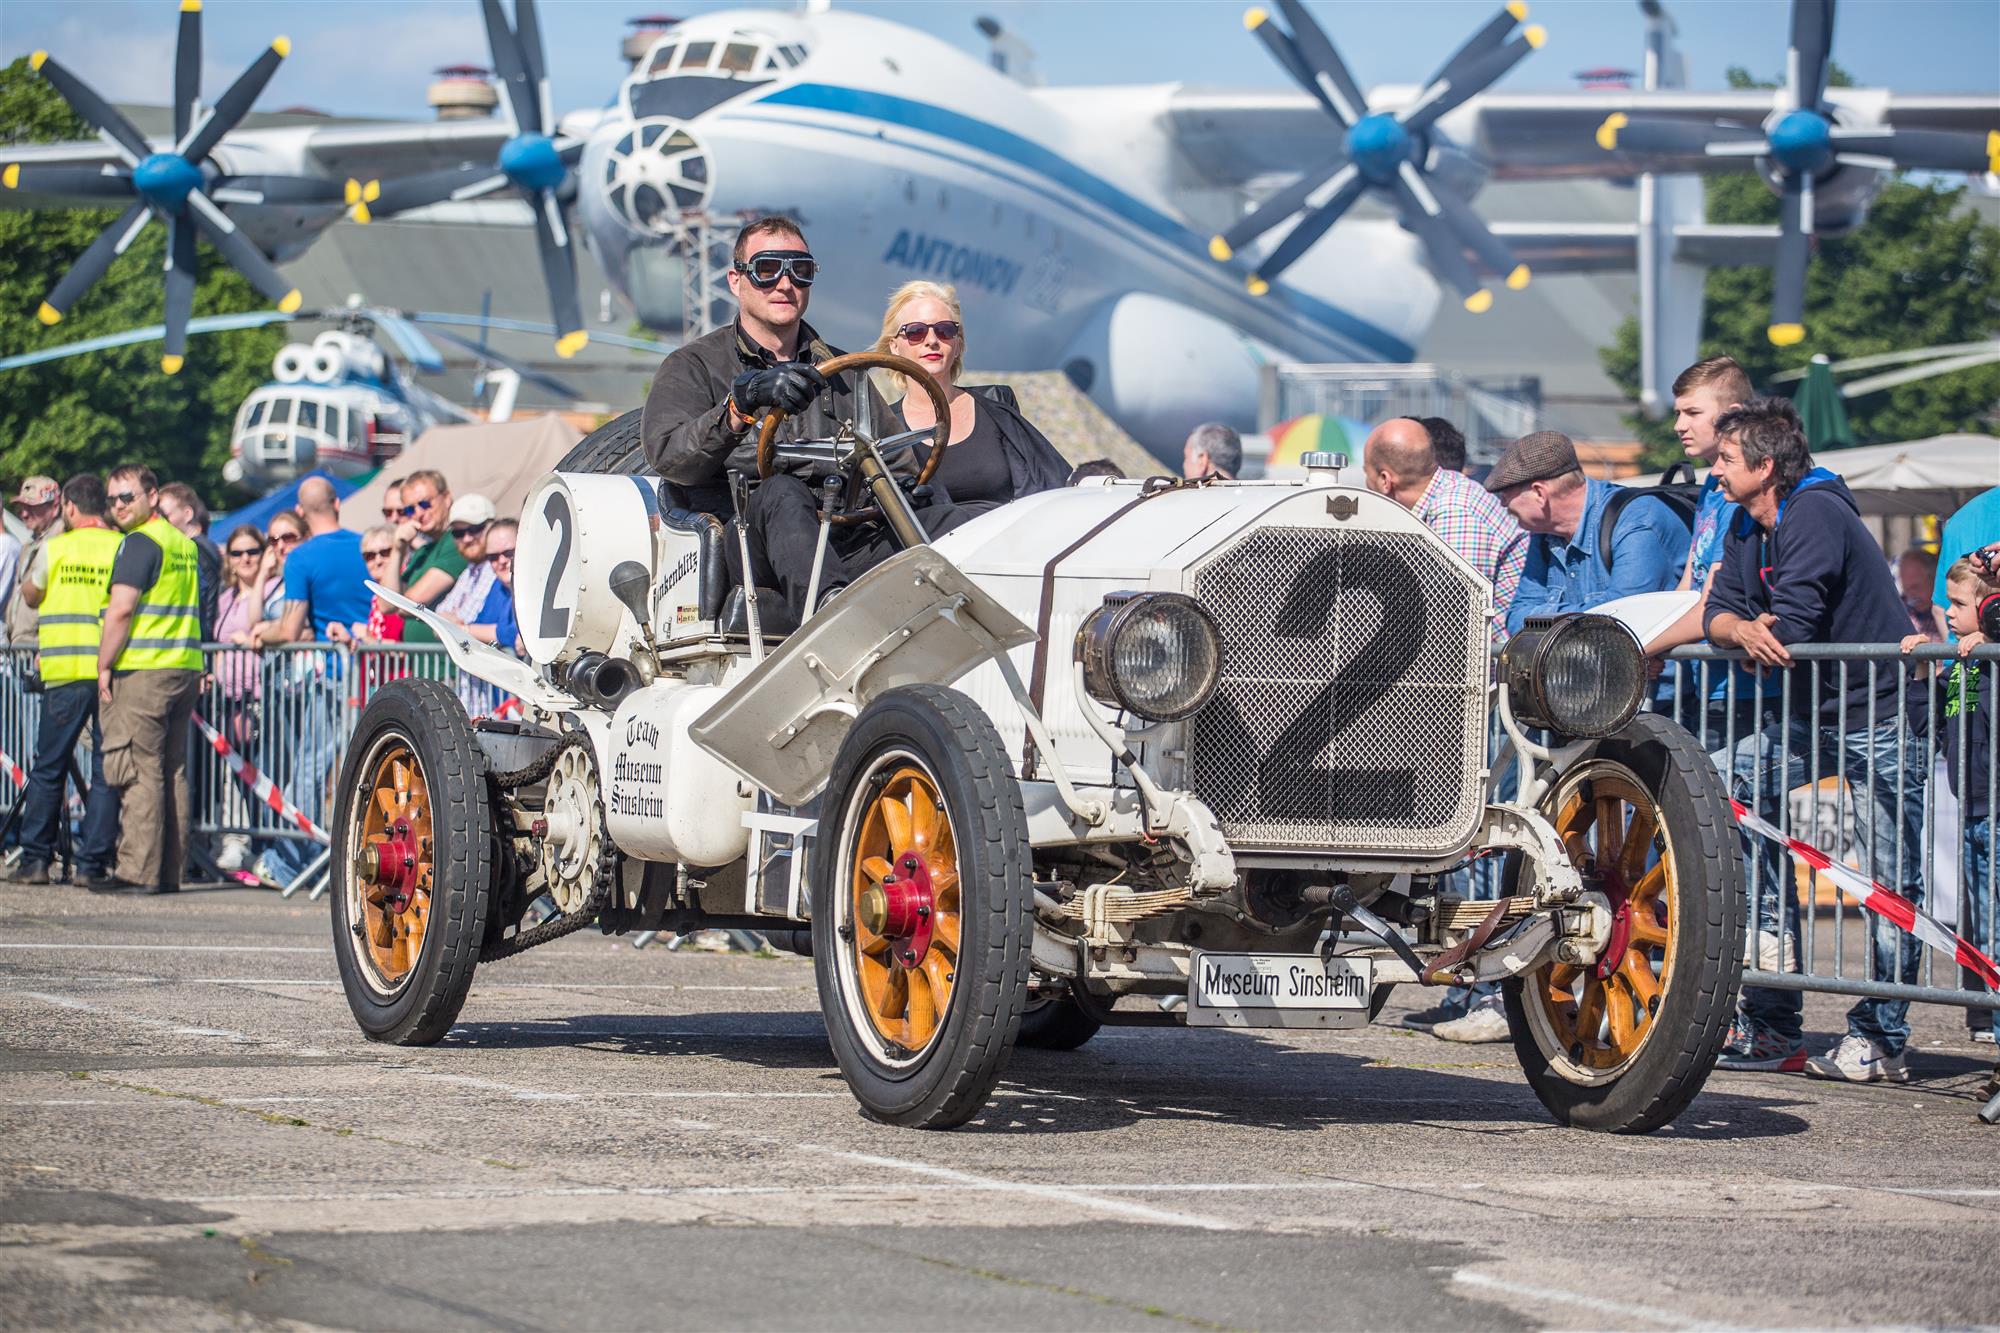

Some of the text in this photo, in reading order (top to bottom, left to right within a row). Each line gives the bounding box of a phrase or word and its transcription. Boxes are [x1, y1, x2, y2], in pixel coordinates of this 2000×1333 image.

[883, 229, 1024, 296] ANTONOV
[539, 491, 572, 639] 2
[1257, 541, 1429, 820] 2
[626, 714, 659, 751] Team
[614, 751, 662, 785] Museum
[610, 784, 663, 821] Sinsheim
[1205, 963, 1365, 997] Museum Sinsheim
